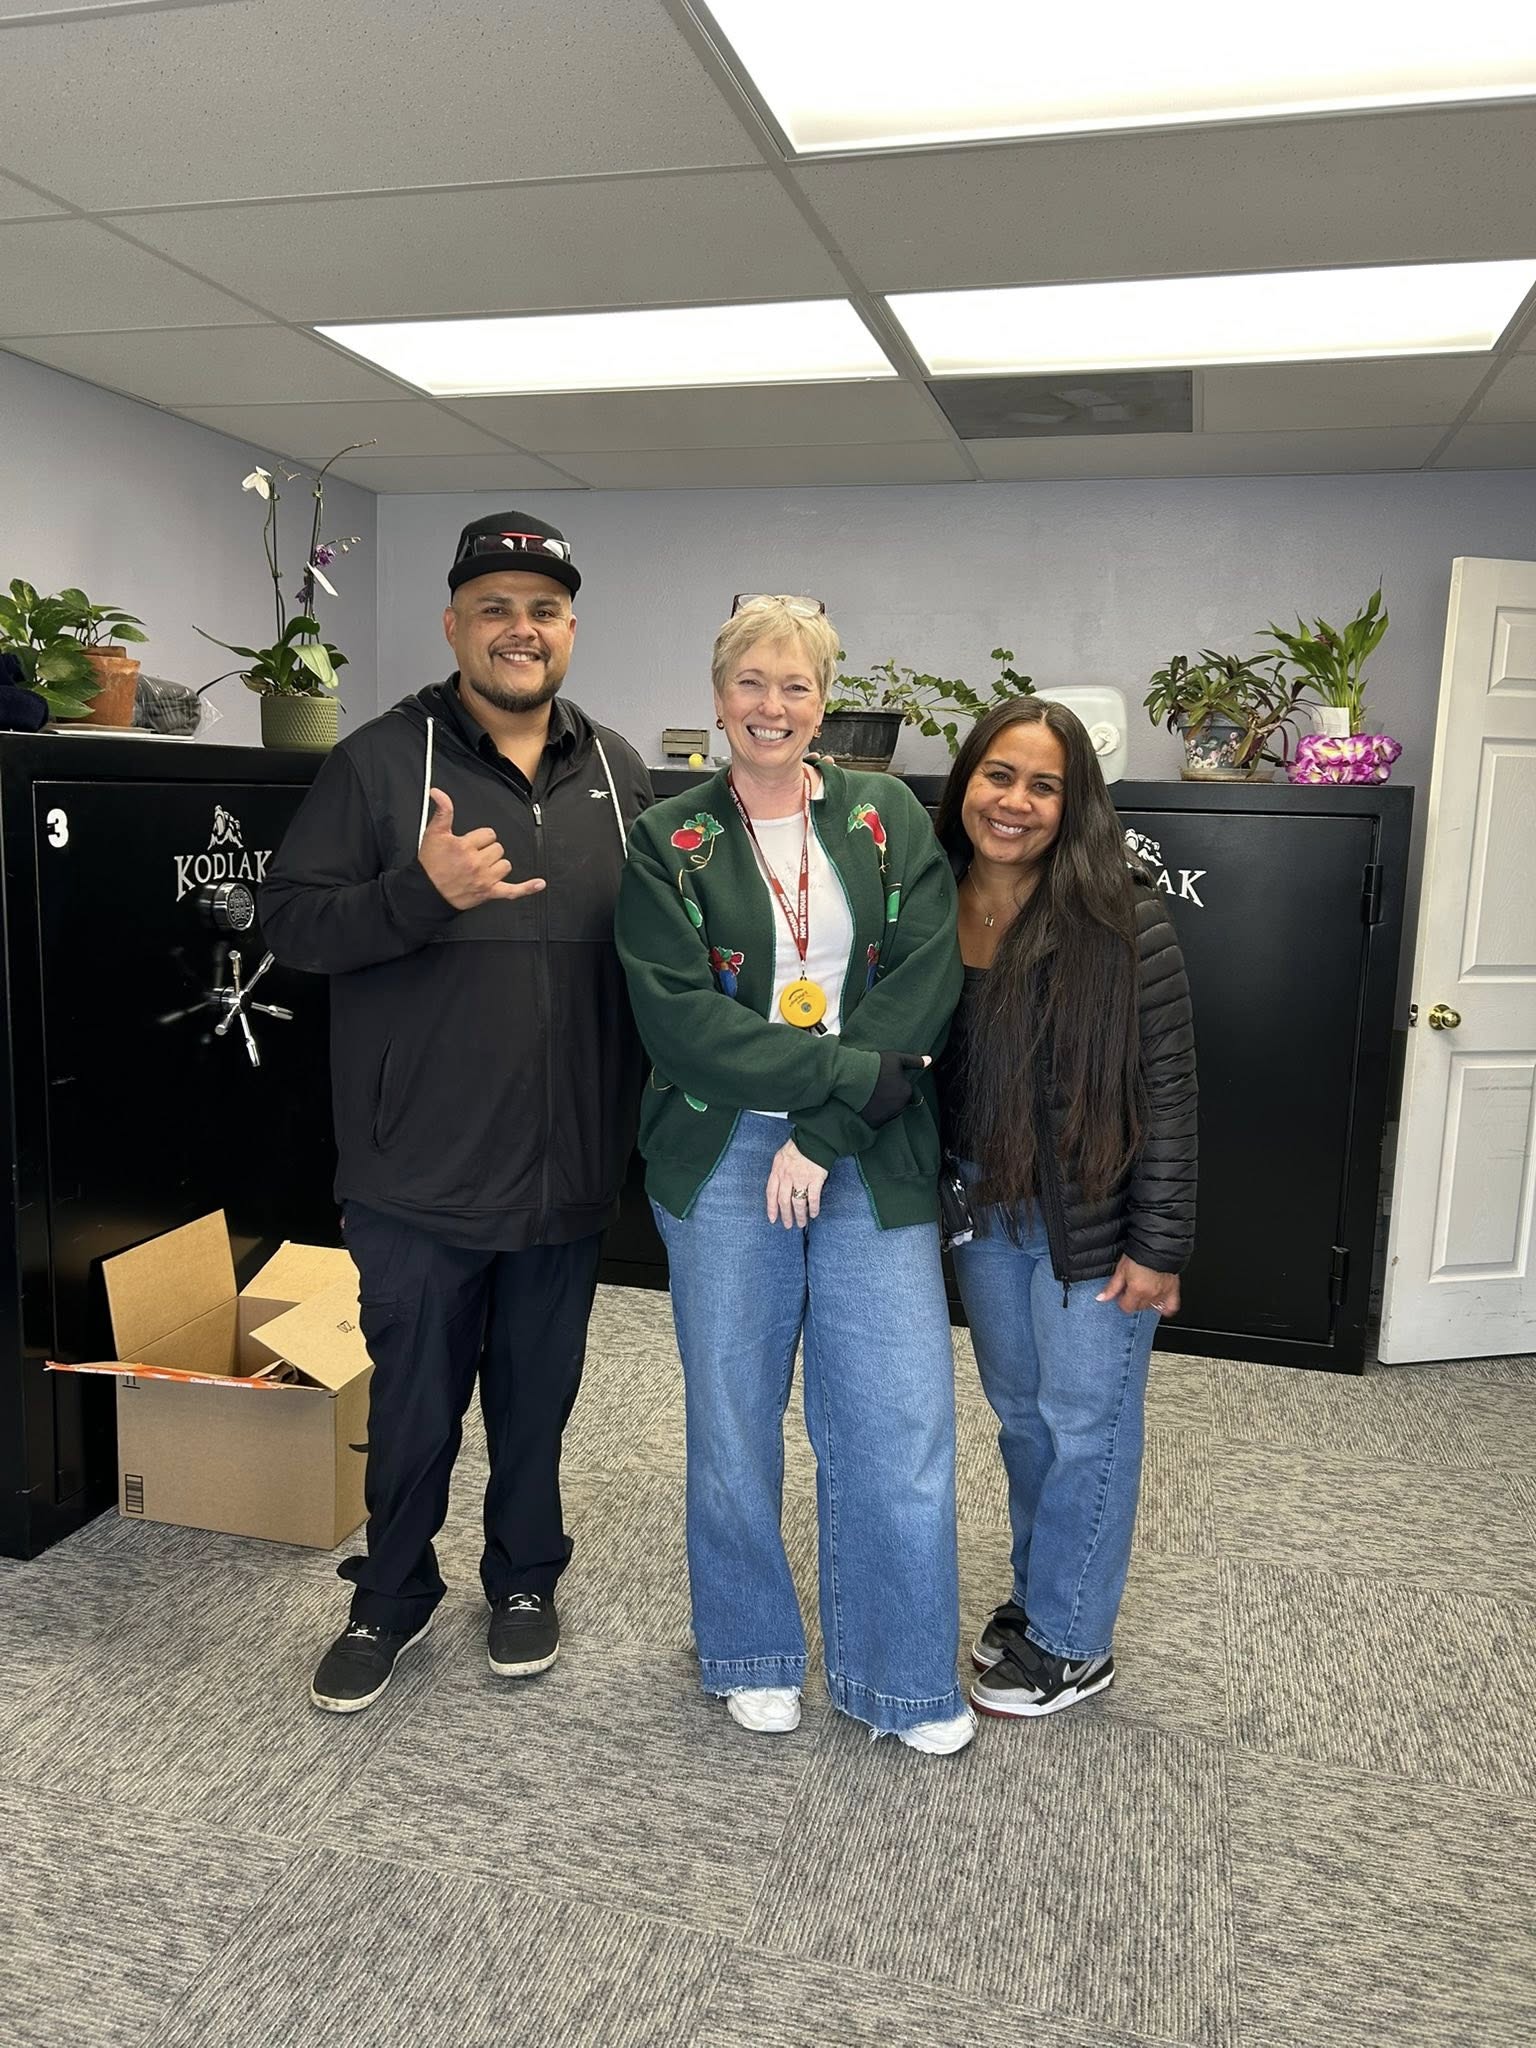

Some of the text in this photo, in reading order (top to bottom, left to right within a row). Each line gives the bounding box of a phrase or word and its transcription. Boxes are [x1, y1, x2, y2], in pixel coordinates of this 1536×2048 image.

[46, 808, 69, 848] 3
[173, 850, 273, 902] KODIAK
[779, 893, 792, 913] HOPE
[799, 890, 807, 915] HOUSE
